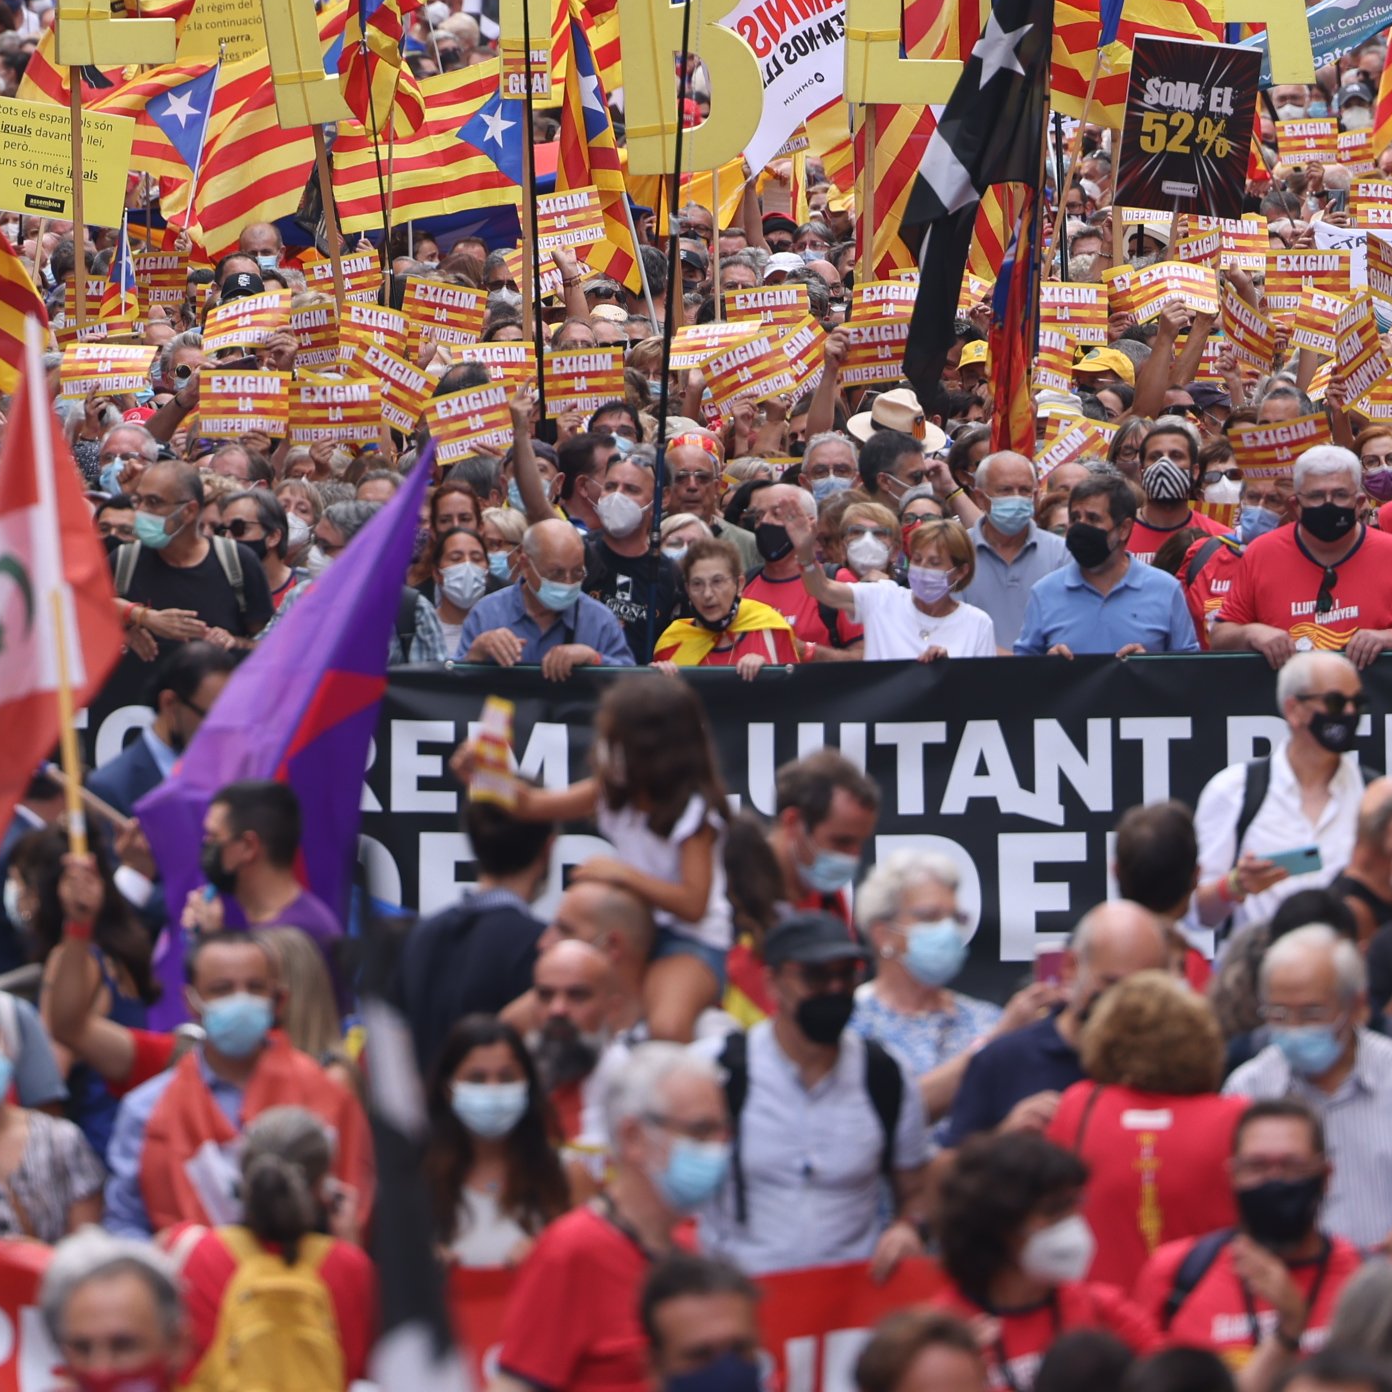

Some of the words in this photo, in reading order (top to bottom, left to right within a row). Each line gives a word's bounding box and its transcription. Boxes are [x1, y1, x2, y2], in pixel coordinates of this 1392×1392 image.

[195, 5, 205, 14] el
[207, 2, 235, 15] règim
[238, 0, 253, 10] del
[194, 19, 202, 31] la
[205, 14, 262, 30] continuació
[1143, 75, 1204, 113] SOM
[1209, 86, 1235, 116] EL
[21, 109, 36, 119] els
[94, 119, 113, 132] són
[0, 121, 32, 138] iguals
[35, 127, 72, 142] davant
[1284, 122, 1332, 137] EXIGIM
[1305, 137, 1316, 148] LA
[20, 160, 39, 172] són
[42, 164, 64, 176] més
[12, 176, 33, 190] que
[29, 197, 61, 209] assemblea
[537, 192, 590, 215] XIGIM
[555, 213, 569, 229] LA
[1222, 235, 1235, 250] LA
[313, 257, 372, 280] EXGIM
[1276, 254, 1340, 272] EXIGIM
[1140, 265, 1205, 287] EXIGIM
[1301, 274, 1313, 289] LA
[1167, 279, 1181, 290] LA
[414, 284, 477, 310] EXIGIM
[735, 289, 798, 310] EXIGIM
[1040, 287, 1098, 304] XIGIM
[216, 294, 281, 321] EXIGIM
[434, 307, 447, 323] LA
[882, 302, 895, 316] LA
[1056, 305, 1070, 321] LA
[1337, 298, 1368, 331] EXIGIM
[237, 314, 252, 327] LA
[291, 309, 327, 329] XIGIM
[350, 306, 405, 333] EXIGIM
[760, 310, 774, 324] LA
[1225, 292, 1268, 340] EXIGIM
[300, 332, 312, 347] LA
[373, 331, 385, 347] LA
[1233, 325, 1245, 341] LA
[705, 336, 719, 347] LA
[1339, 332, 1364, 366] HEM
[75, 346, 146, 360] EXIGIM
[462, 348, 526, 364] EXIGIM
[709, 336, 773, 377] EXIGIM
[877, 345, 892, 360] LA
[97, 359, 112, 373] LA
[364, 347, 426, 392] EXIGIM
[552, 353, 613, 375] EXIGIM
[791, 360, 809, 377] LA
[490, 366, 504, 379] LA
[737, 366, 753, 384] LA
[211, 375, 281, 394] EXIGIM
[574, 375, 588, 392] LA
[300, 385, 370, 403] EXIGIM
[237, 396, 253, 412] LA
[435, 386, 508, 420] EXIGIM
[328, 406, 343, 422] LA
[468, 415, 485, 431] LA
[1241, 419, 1317, 448] EXIGIM
[1275, 446, 1292, 461] LA
[1315, 606, 1358, 625] GUANYEM
